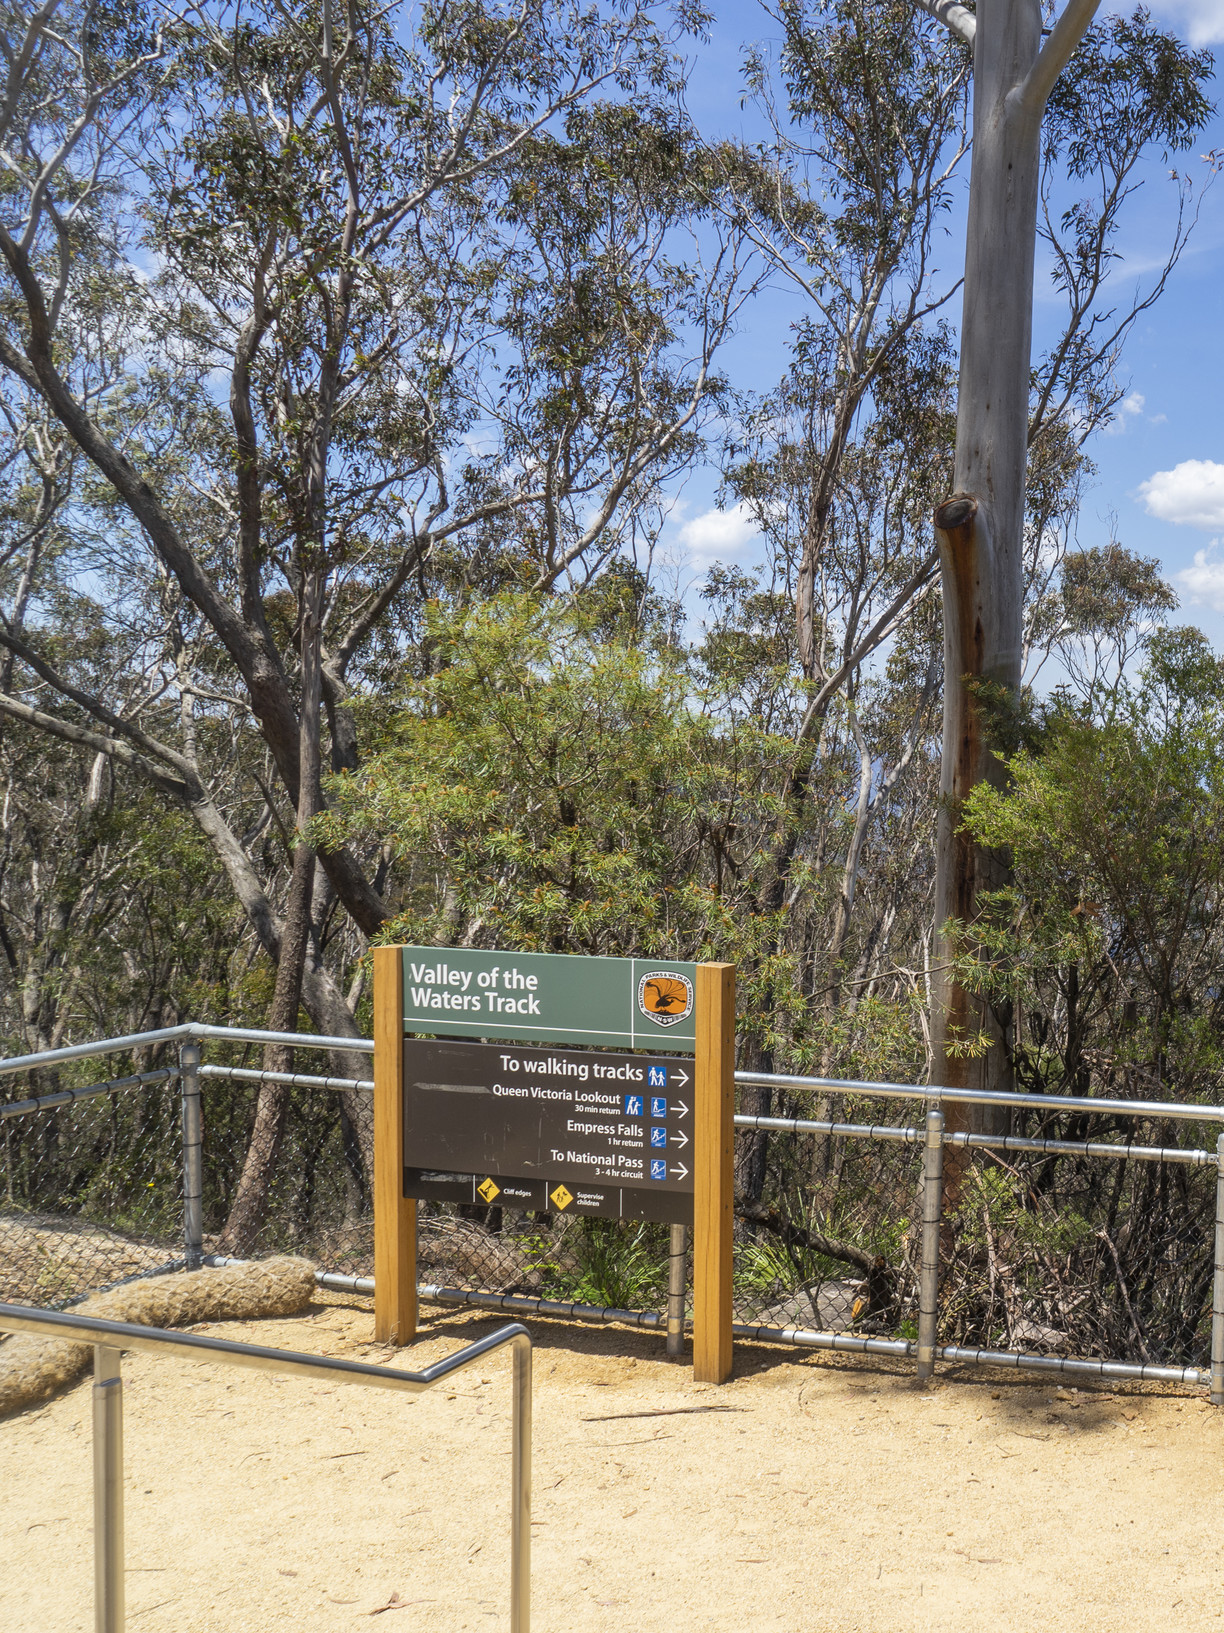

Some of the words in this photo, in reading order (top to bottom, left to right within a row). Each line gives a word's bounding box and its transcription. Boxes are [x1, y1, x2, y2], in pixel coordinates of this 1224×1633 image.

[411, 963, 472, 991] Valley
[477, 967, 500, 987] of
[503, 968, 538, 990] the
[411, 987, 481, 1010] Waters
[484, 992, 541, 1014] Track
[500, 1055, 519, 1071] To
[524, 1058, 588, 1081] walking
[593, 1063, 643, 1081] tracks
[492, 1084, 528, 1097] Queen
[530, 1087, 572, 1100] Victoria
[575, 1090, 621, 1104] Lookout
[575, 1104, 584, 1112] 30
[599, 1107, 621, 1115] return
[567, 1119, 615, 1135] Empress
[618, 1124, 643, 1137] Falls
[550, 1149, 564, 1161] To
[567, 1151, 615, 1166] National
[618, 1155, 643, 1168] Pass
[605, 1168, 610, 1176] 4
[611, 1169, 620, 1177] hr
[621, 1170, 643, 1179] circuit
[515, 1189, 532, 1197] edges
[577, 1192, 604, 1200] Supervise
